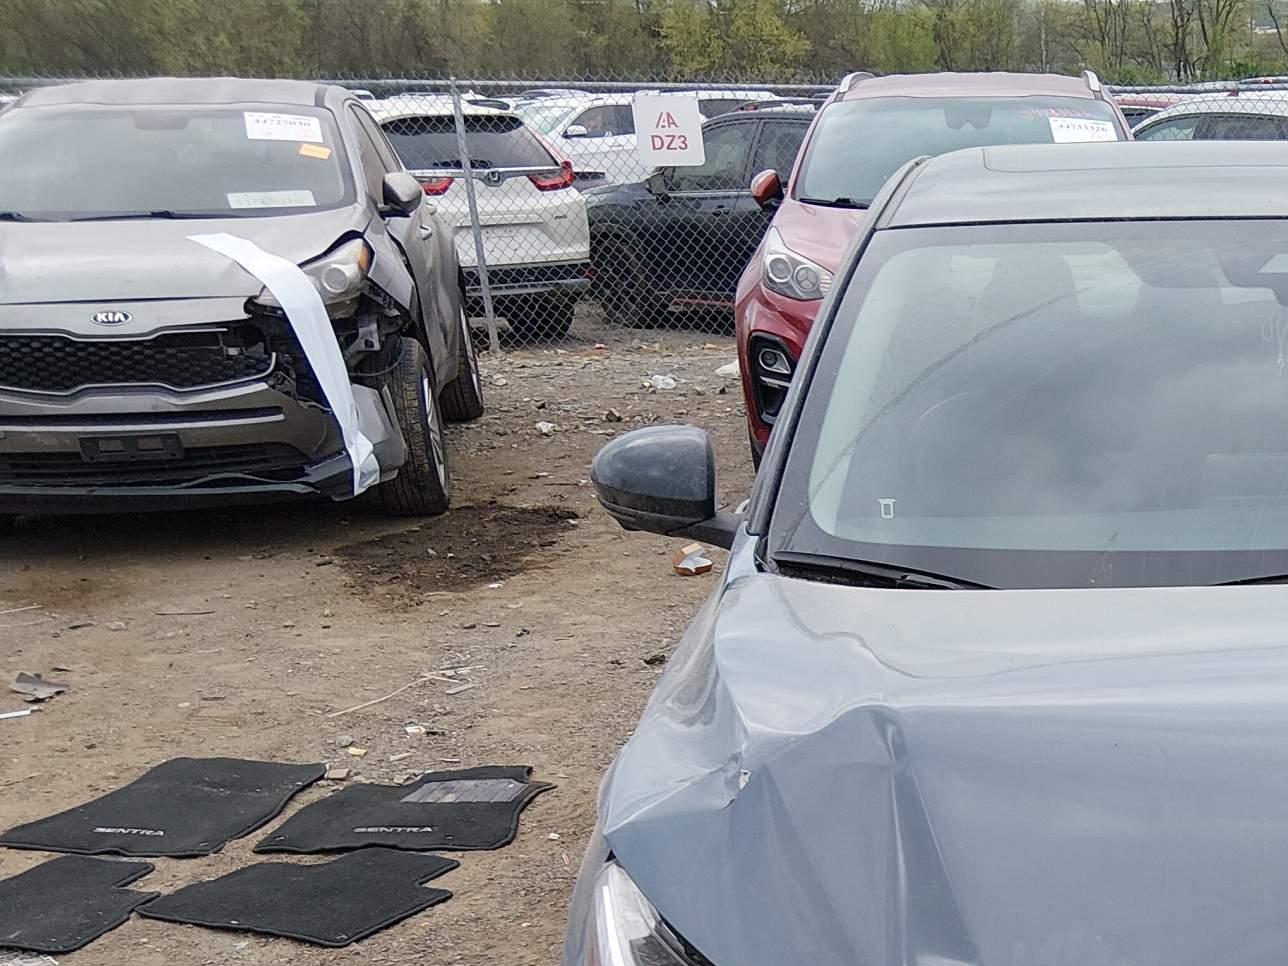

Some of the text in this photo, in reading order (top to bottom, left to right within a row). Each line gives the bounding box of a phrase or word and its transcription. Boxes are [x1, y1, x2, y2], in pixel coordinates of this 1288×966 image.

[651, 135, 688, 151] DZ3
[97, 312, 126, 322] KIA
[92, 827, 165, 836] SENTRA
